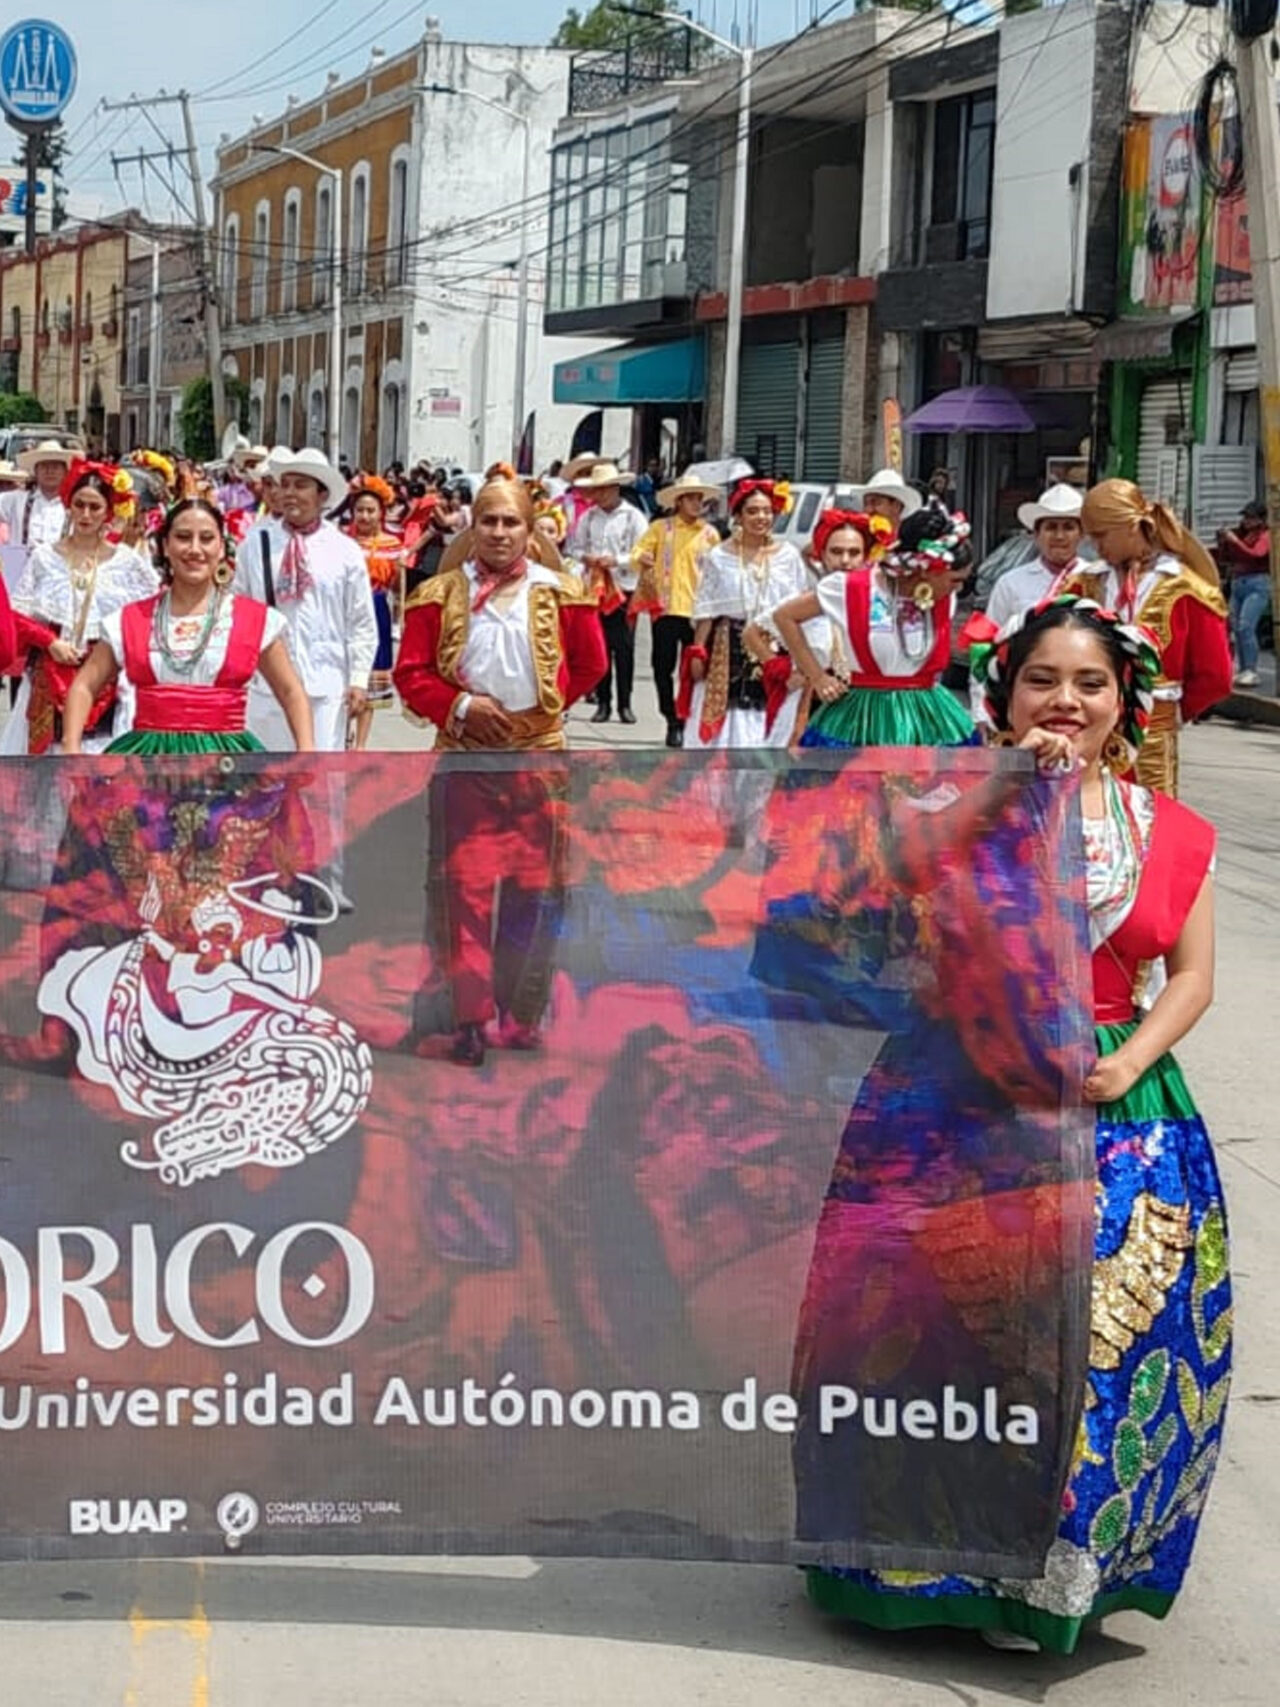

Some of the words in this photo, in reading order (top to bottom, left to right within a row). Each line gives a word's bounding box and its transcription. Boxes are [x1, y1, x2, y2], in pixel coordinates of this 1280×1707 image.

[373, 1372, 701, 1430] Autónoma
[721, 1376, 798, 1433] de
[820, 1385, 1039, 1444] Puebla
[265, 1502, 335, 1514] COMPLEJO
[338, 1501, 402, 1514] CULTURAL
[266, 1513, 362, 1524] UNIVERSITARIO
